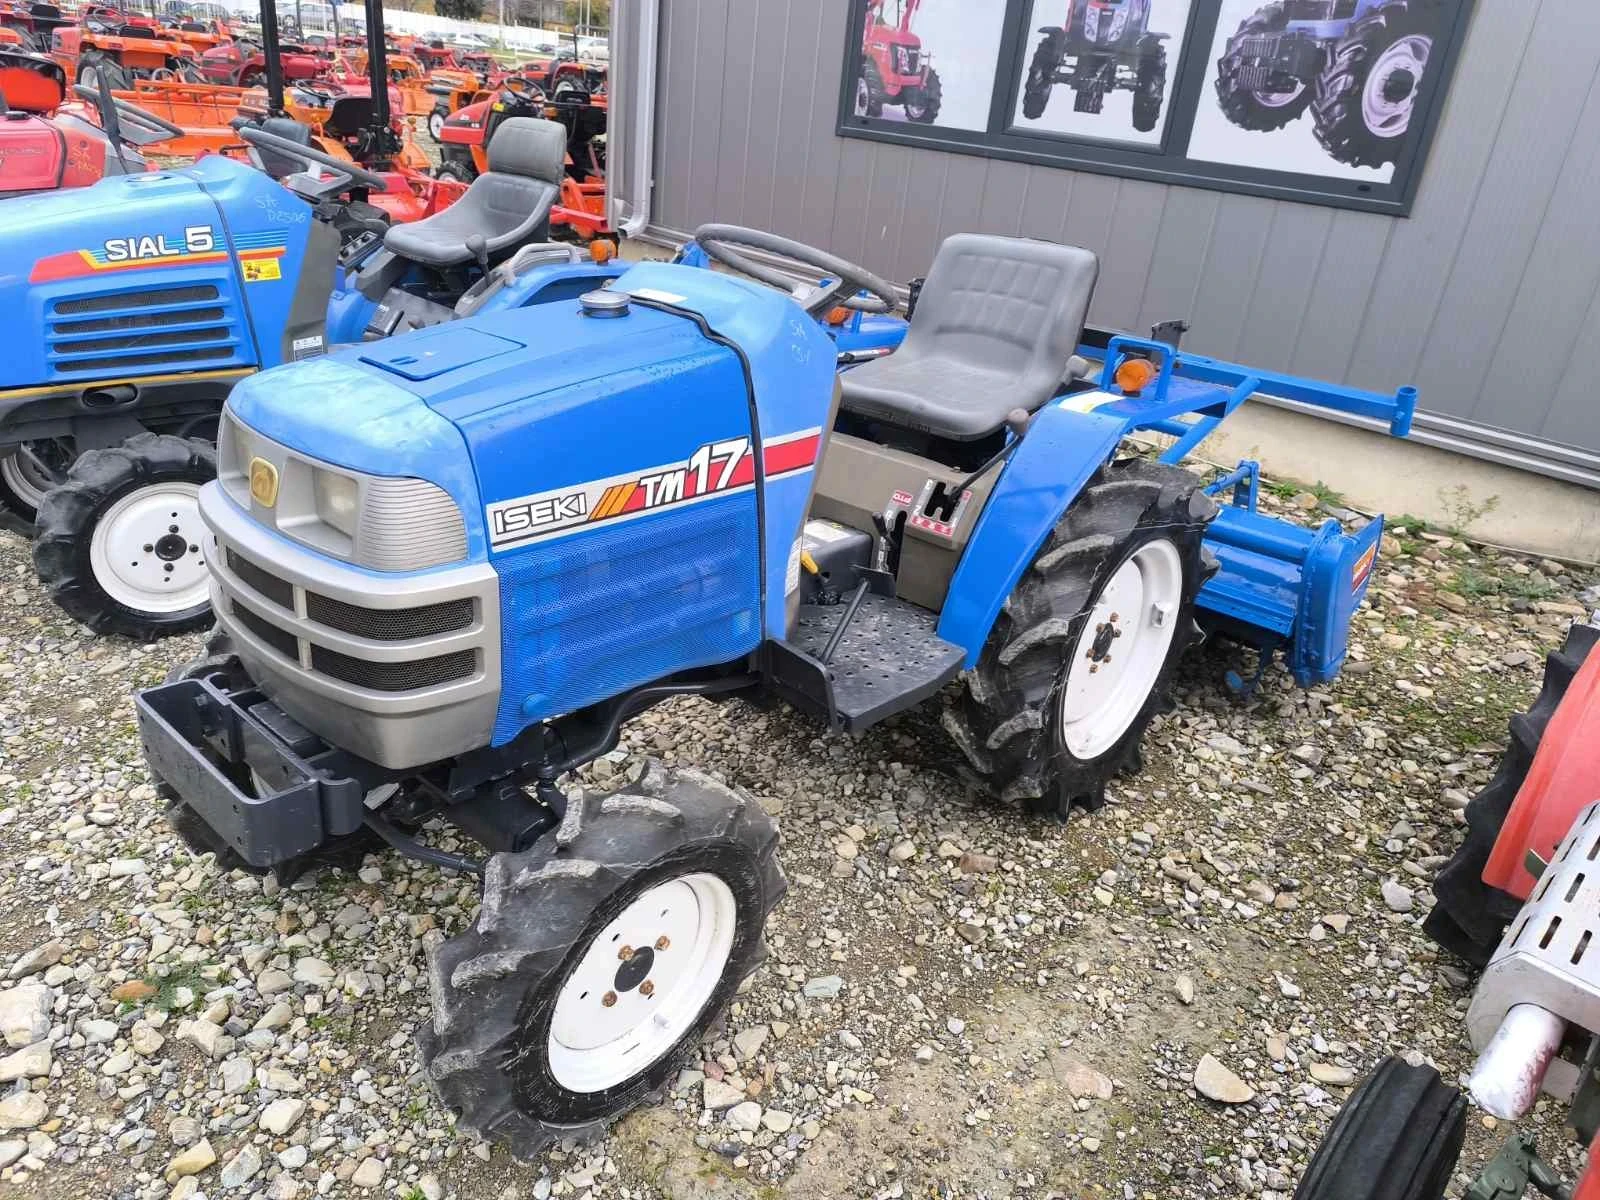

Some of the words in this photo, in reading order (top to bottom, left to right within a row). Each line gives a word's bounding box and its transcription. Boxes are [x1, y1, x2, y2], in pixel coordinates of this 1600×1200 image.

[104, 235, 180, 261] SIAL
[184, 225, 214, 252] 5
[495, 492, 588, 536] ISEKI
